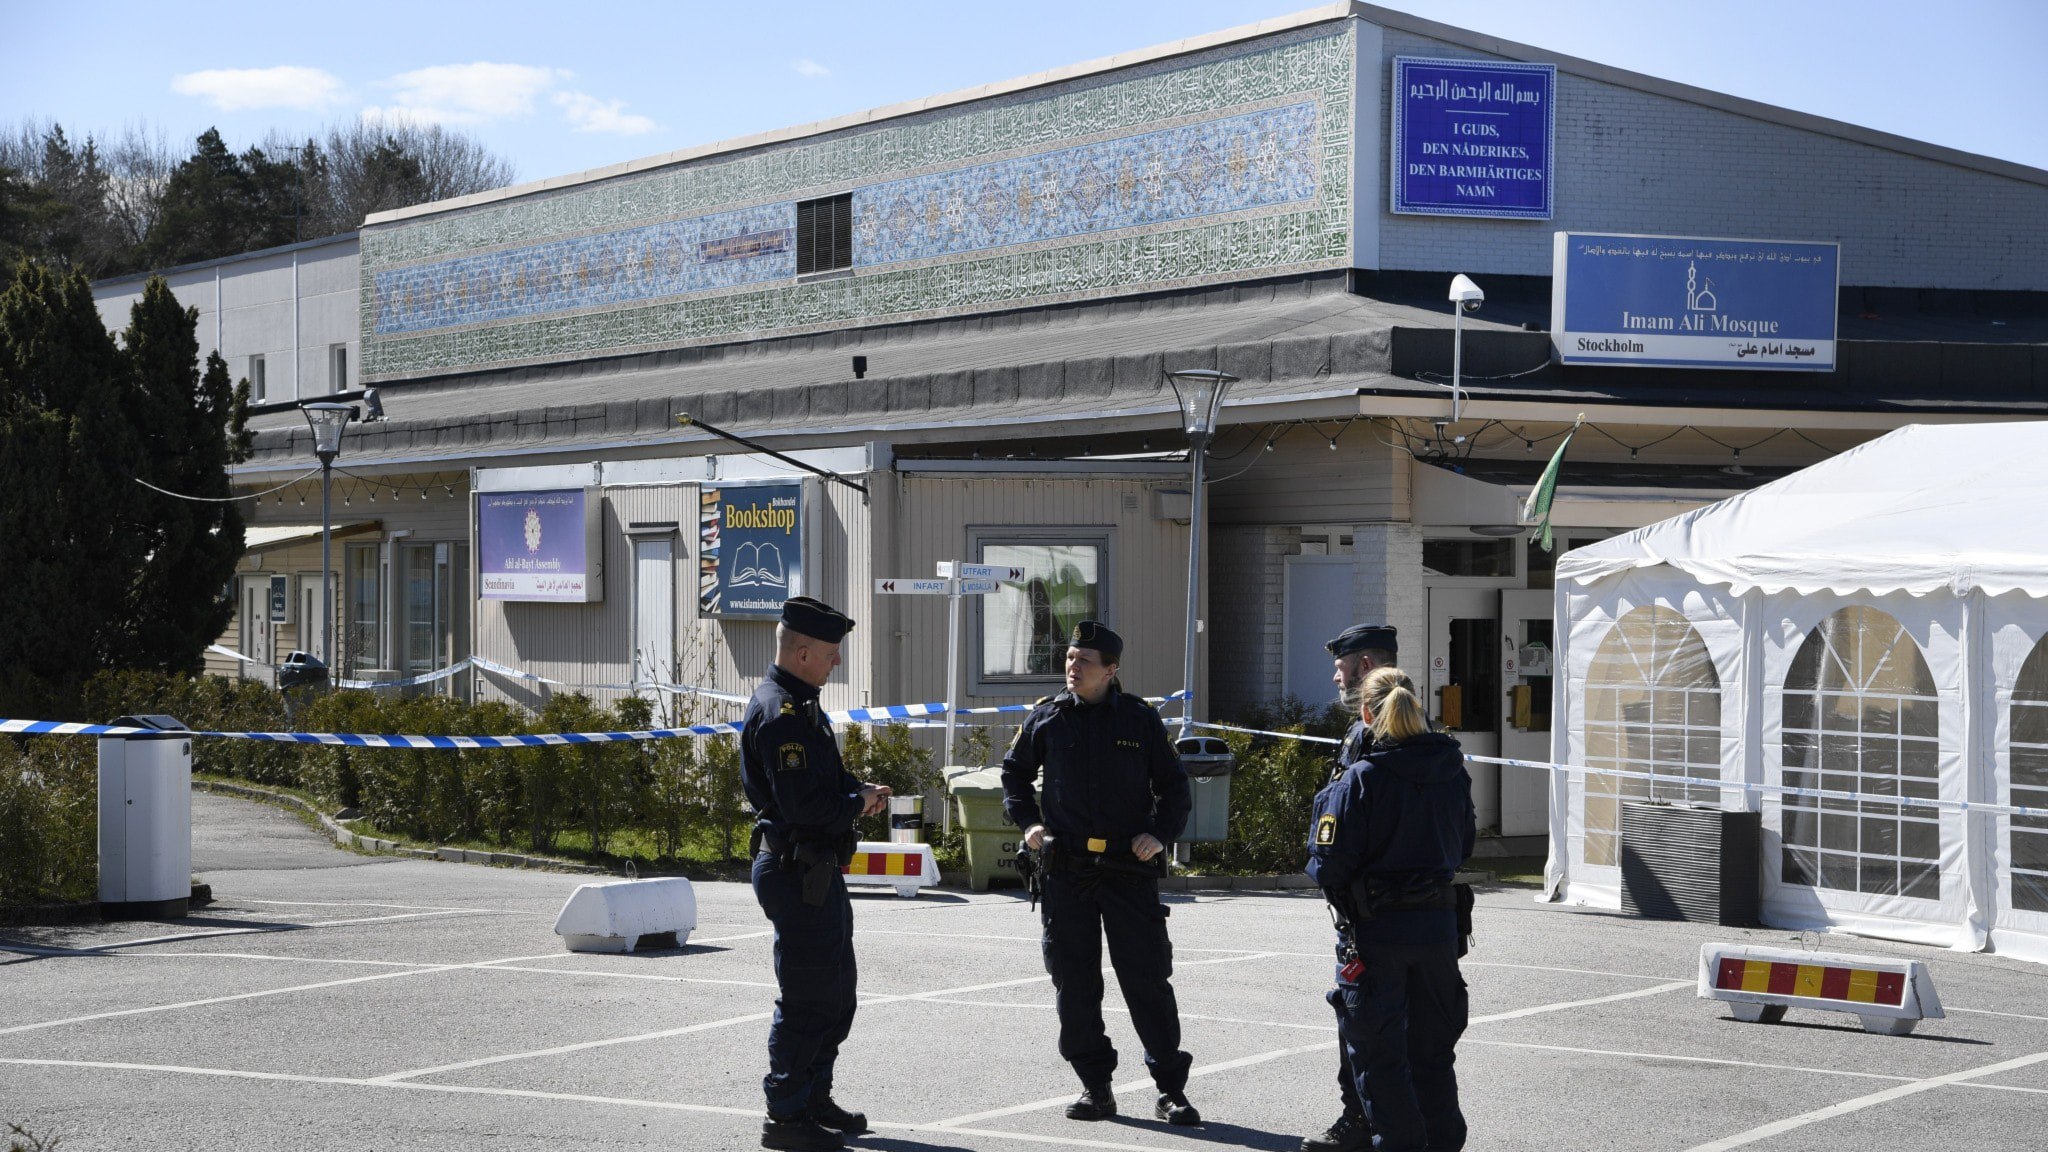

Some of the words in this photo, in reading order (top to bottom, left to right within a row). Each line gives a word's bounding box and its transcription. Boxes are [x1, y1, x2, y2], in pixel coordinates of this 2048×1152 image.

[1411, 78, 1449, 101] الرحيم
[1451, 80, 1491, 103] الرحمن
[1494, 83, 1514, 104] الله
[1516, 89, 1540, 106] بسم
[1453, 122, 1459, 135] I
[1461, 123, 1500, 138] GUDS,
[1422, 142, 1449, 155] DEN
[1452, 142, 1530, 160] NÅDERIKES,
[1409, 163, 1436, 176] DEN
[1439, 164, 1543, 181] BARMHÄRTIGES
[1456, 184, 1496, 198] NAMN
[1623, 311, 1674, 330] Imam
[1679, 314, 1704, 331] Ali
[1711, 315, 1779, 338] Mosque
[1577, 338, 1644, 353] Stockholm
[1785, 343, 1815, 360] مسجد
[726, 502, 795, 535] Bookshop
[535, 558, 561, 572] Assembly
[963, 566, 992, 576] UTFART
[484, 578, 515, 590] Scandinavia
[913, 582, 945, 590] INFART
[1116, 740, 1140, 748] POLIS
